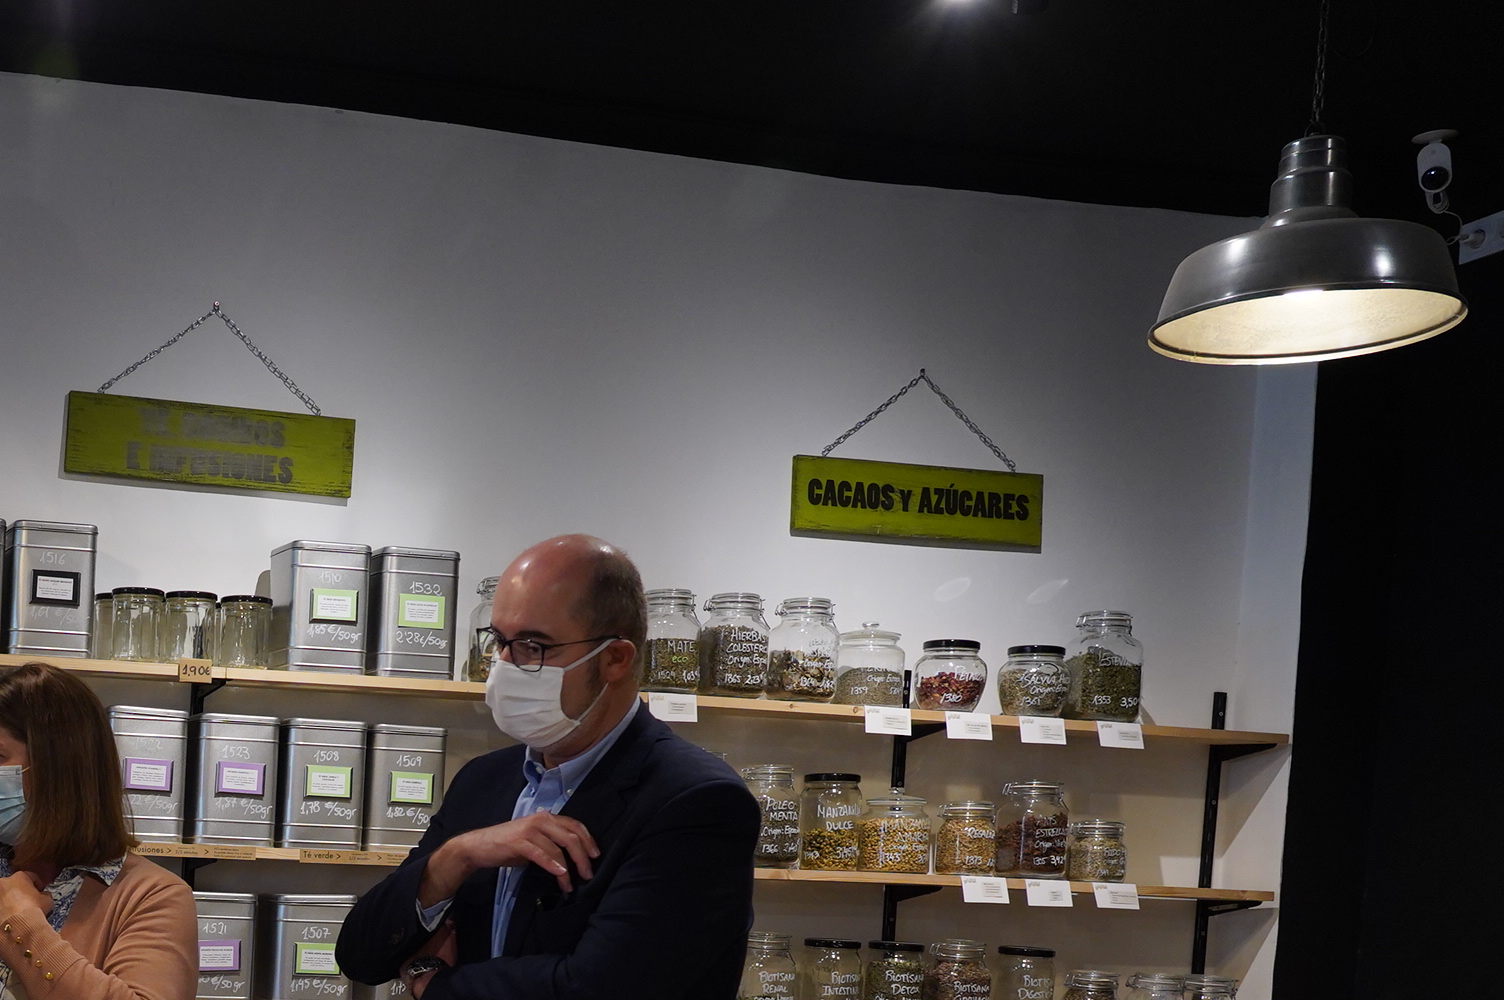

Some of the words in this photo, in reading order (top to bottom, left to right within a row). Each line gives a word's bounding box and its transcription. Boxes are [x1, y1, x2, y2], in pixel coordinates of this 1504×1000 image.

[807, 478, 895, 511] CACAOS
[900, 489, 912, 512] Y
[918, 483, 1030, 521] AZÚCARES
[409, 581, 443, 597] 1532
[667, 640, 696, 653] MATE
[222, 745, 252, 761] 1523
[313, 750, 341, 763] 1508
[396, 754, 423, 768] 1509
[765, 798, 796, 811] POLEO
[769, 811, 798, 822] MENTA
[826, 820, 854, 831] DULCE
[130, 845, 164, 855] nfusiones
[303, 850, 312, 859] Té
[314, 851, 334, 860] verde
[301, 926, 332, 940] 1507
[759, 971, 796, 983] BIOTISAN
[885, 969, 924, 983] BIOTISAN
[763, 983, 789, 994] RENAL
[891, 983, 919, 996] DETOX
